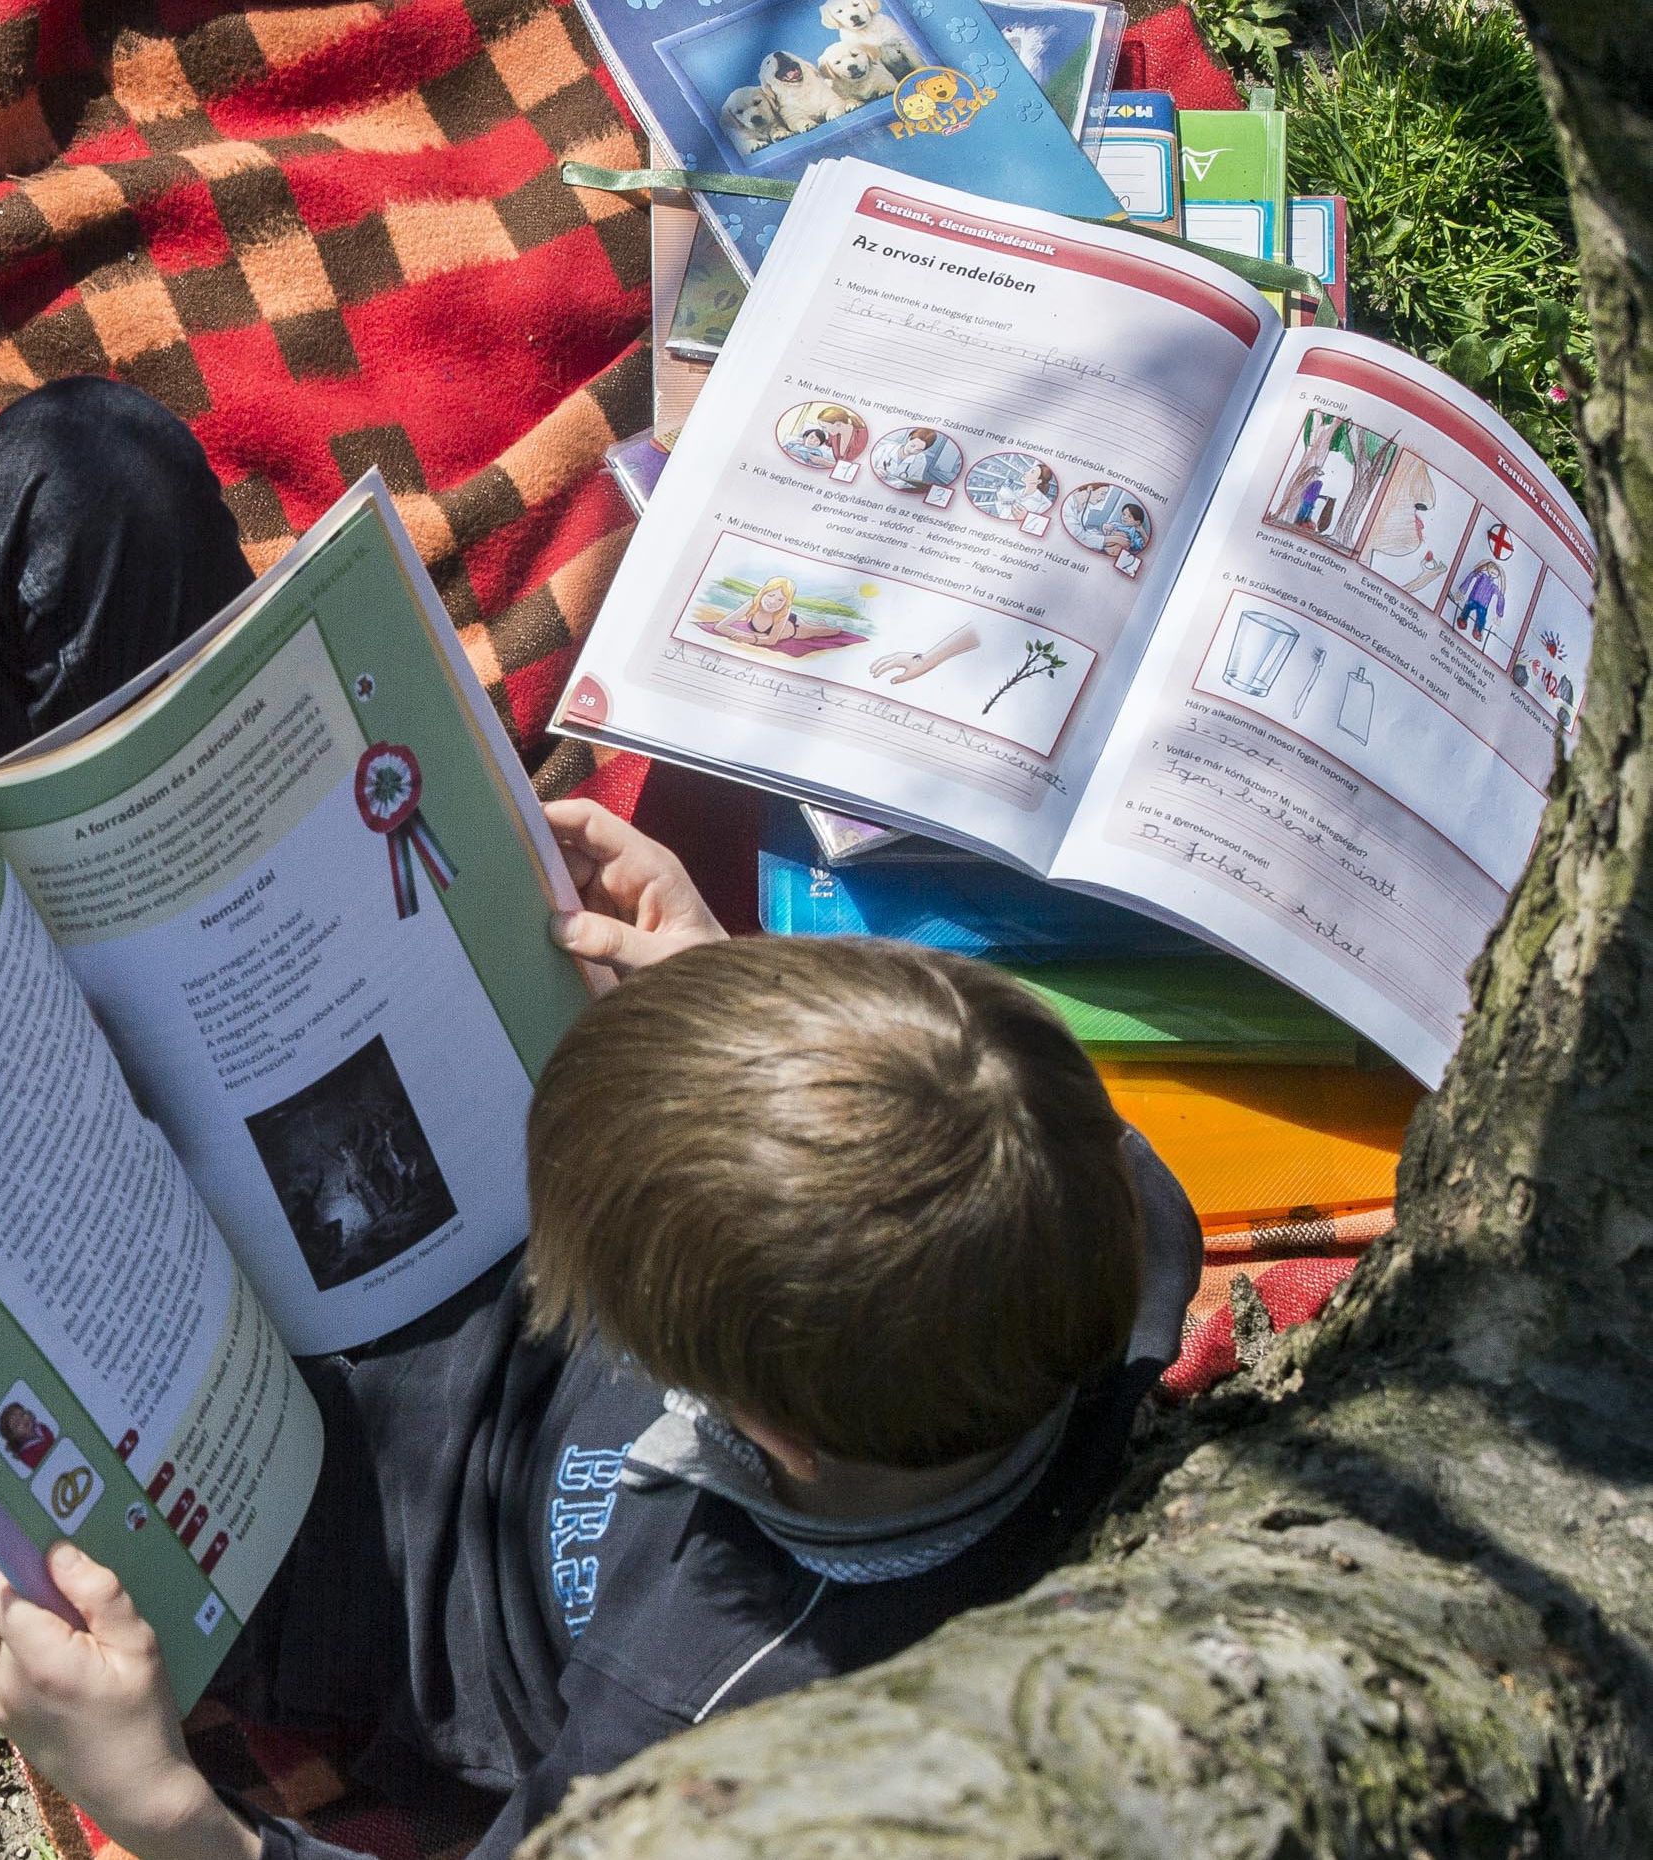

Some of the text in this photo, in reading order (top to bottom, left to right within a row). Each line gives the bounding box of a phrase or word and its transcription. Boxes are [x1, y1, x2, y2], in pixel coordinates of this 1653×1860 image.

[876, 199, 1056, 256] Testünk, életműködésünk
[852, 234, 1036, 294] Az orvosi rendelőben
[834, 278, 842, 286] 1.
[846, 281, 879, 297] Melyek
[880, 290, 921, 308] lehetnek
[930, 304, 974, 324] betegség
[1299, 391, 1349, 412] 5. Rajzolj!
[784, 374, 792, 384] 2.
[797, 379, 813, 390] Mit
[814, 384, 832, 395] kell
[859, 397, 872, 407] ha
[873, 402, 942, 424] megbetegszel?
[942, 418, 985, 437] Számozd
[985, 431, 1007, 444] meg
[1016, 438, 1054, 456] képeket
[1055, 450, 1105, 473] történésük
[1101, 469, 1168, 505] sorrendjében!
[1496, 454, 1539, 503] Testünk,
[739, 462, 748, 471] 3.
[752, 466, 768, 477] Kik
[769, 472, 815, 492] segítenek
[823, 490, 884, 510] gyógyításban
[885, 504, 897, 514] és
[898, 509, 910, 517] az
[911, 513, 968, 534] egészséged
[968, 528, 1044, 556] megőrzésében?
[1044, 551, 1070, 566] Húzd
[1070, 562, 1090, 574] alá!
[811, 503, 869, 523] gyerekorvos
[879, 520, 915, 534] védőnő
[714, 512, 722, 520] 4.
[727, 516, 740, 526] Mi
[739, 520, 783, 541] jelenthet
[784, 536, 821, 552] veszélyt
[822, 547, 891, 570] egészségünkre
[901, 566, 972, 592] természetben?
[996, 596, 1025, 611] rajzok
[1026, 606, 1046, 618] alá!
[826, 522, 1013, 580] orvosi asszisztens kőműves fogorvos
[1256, 531, 1347, 574] Panniék az erdőben
[1269, 547, 1325, 576] kirándultak.
[1344, 581, 1428, 640] ismeretlen bogyóból!
[1361, 577, 1420, 622] Evett egy szép,
[1223, 572, 1232, 581] 6.
[1236, 574, 1248, 584] Mi
[1249, 580, 1298, 604] szükséges
[1308, 602, 1371, 642] fogápoláshoz?
[1371, 639, 1410, 671] Egészítsd
[1410, 665, 1419, 676] ki
[1425, 677, 1451, 701] rajzot!
[1439, 631, 1496, 683] Este rosszul lett,
[1430, 654, 1489, 705] orvosi ügyeletre.
[1440, 647, 1488, 688] és elvitték az
[577, 694, 597, 707] 38
[1509, 691, 1542, 724] Kórházba
[1185, 699, 1360, 795] Hány alkalommal mosol fogat naponta?
[75, 828, 88, 841] A
[88, 785, 170, 836] forradalom
[171, 773, 186, 789] és
[187, 765, 196, 777] a
[196, 724, 241, 769] márciusi
[1152, 741, 1159, 750] 7.
[1165, 744, 1202, 763] Voltál-e
[1203, 758, 1224, 772] már
[1225, 767, 1279, 800] kórházban?
[1279, 796, 1291, 807] Mi
[1293, 804, 1308, 818] volt
[1316, 819, 1368, 858] betegséged?
[1124, 800, 1271, 870] 8. Írd le a gyerekorvosod nevét!
[200, 869, 276, 930] Nemzeti dal
